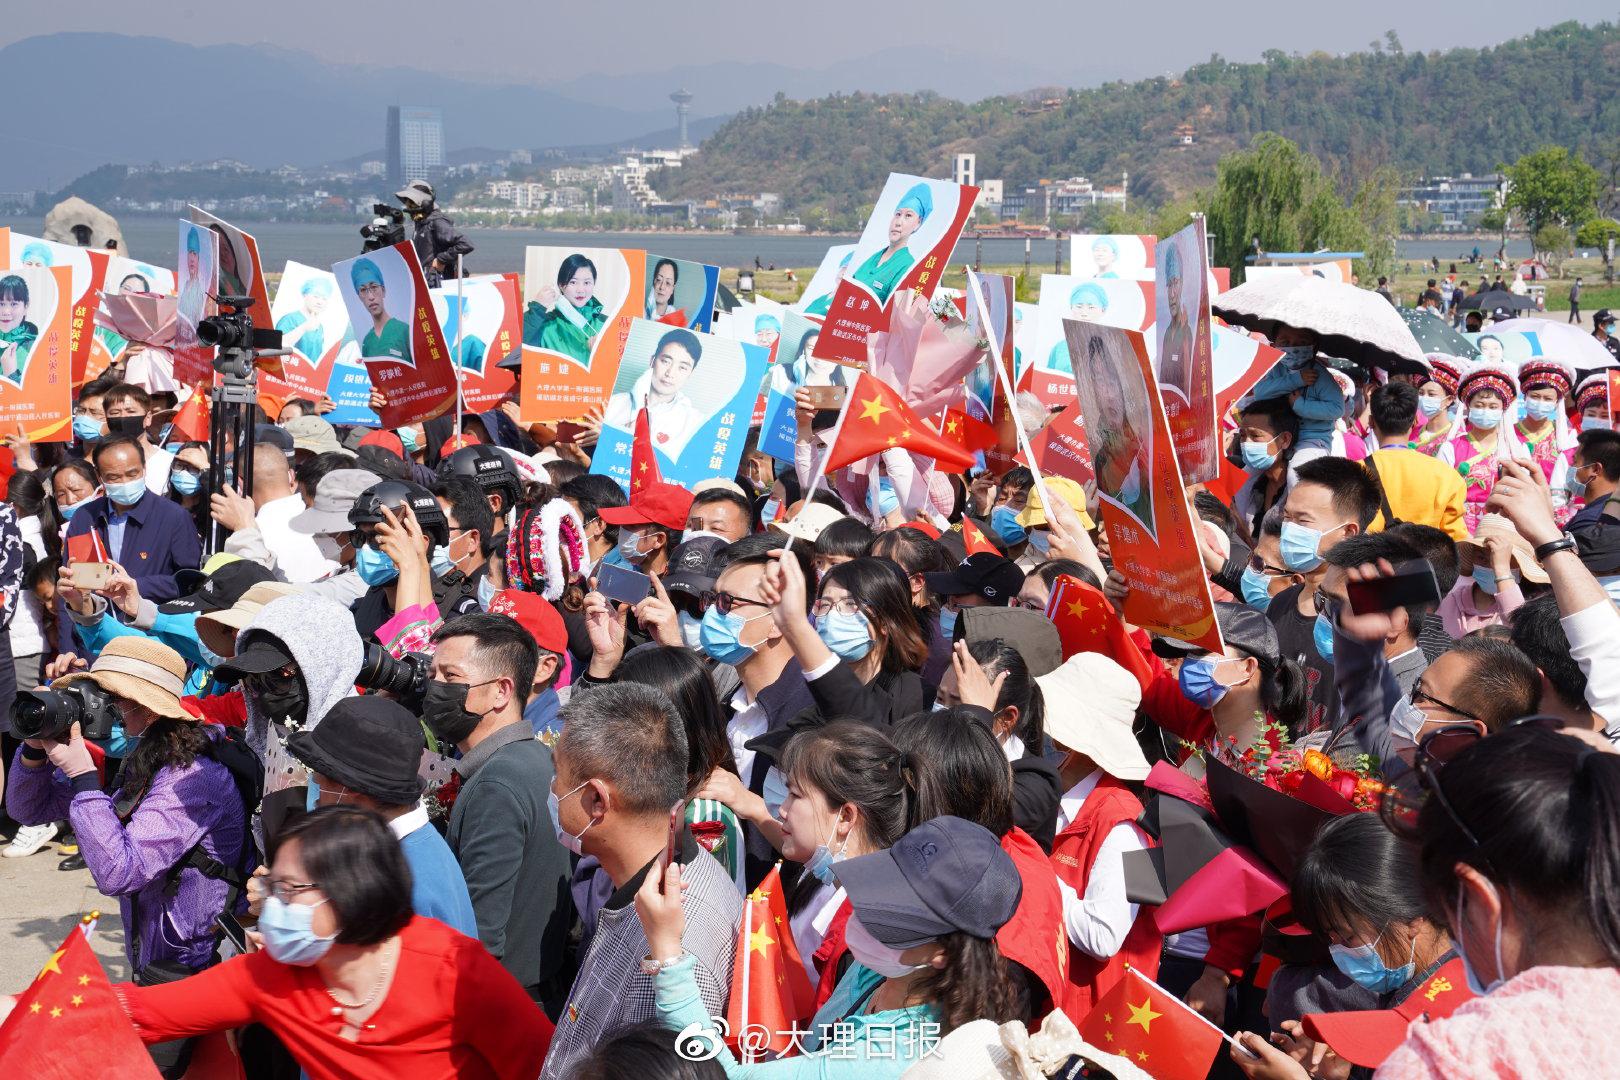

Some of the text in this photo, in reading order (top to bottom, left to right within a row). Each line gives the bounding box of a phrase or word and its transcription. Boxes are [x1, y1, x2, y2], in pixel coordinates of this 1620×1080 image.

[417, 307, 440, 360] 战疫英雄
[707, 412, 735, 470] 战疫英雄
